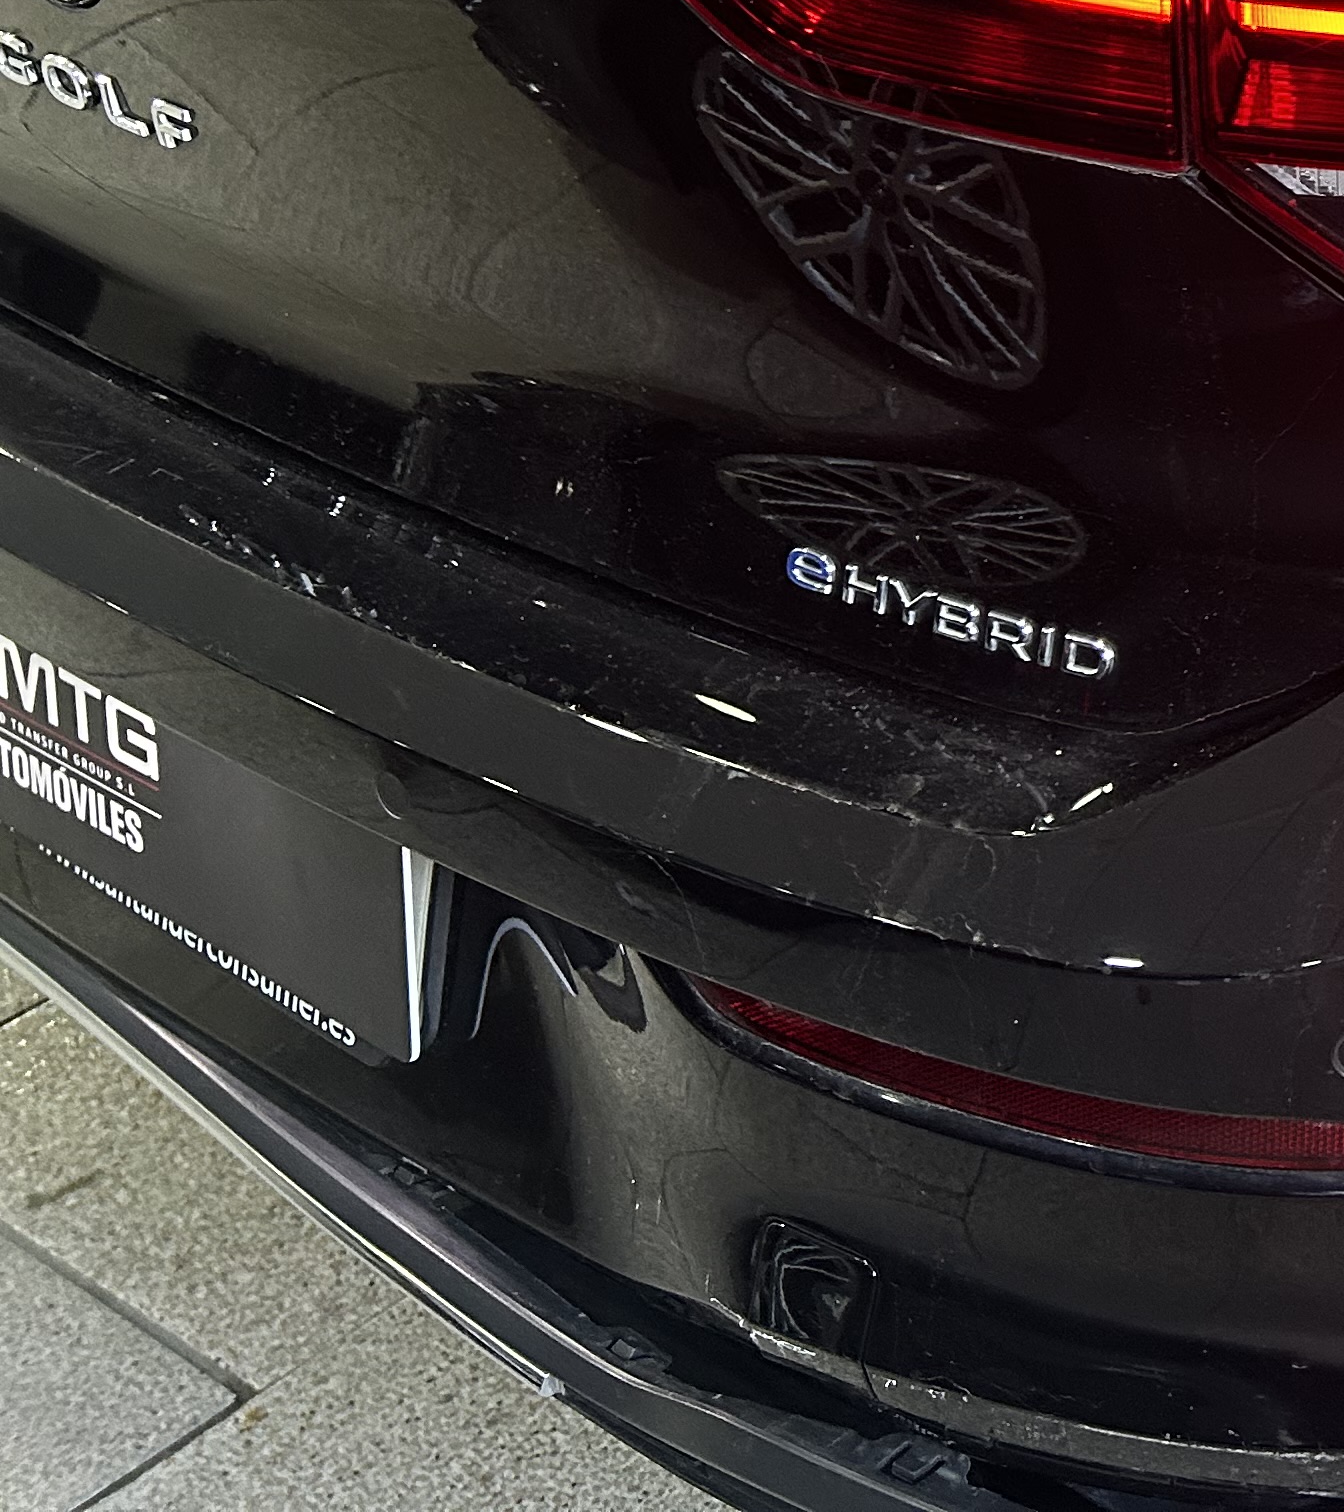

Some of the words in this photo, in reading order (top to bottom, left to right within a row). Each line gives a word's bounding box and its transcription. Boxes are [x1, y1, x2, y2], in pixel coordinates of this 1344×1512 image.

[0, 30, 196, 149] GOLF
[787, 547, 1117, 677] eHYBRID
[0, 634, 160, 781] MTG
[11, 717, 69, 760] TRANSFER
[73, 750, 112, 782] GROUP
